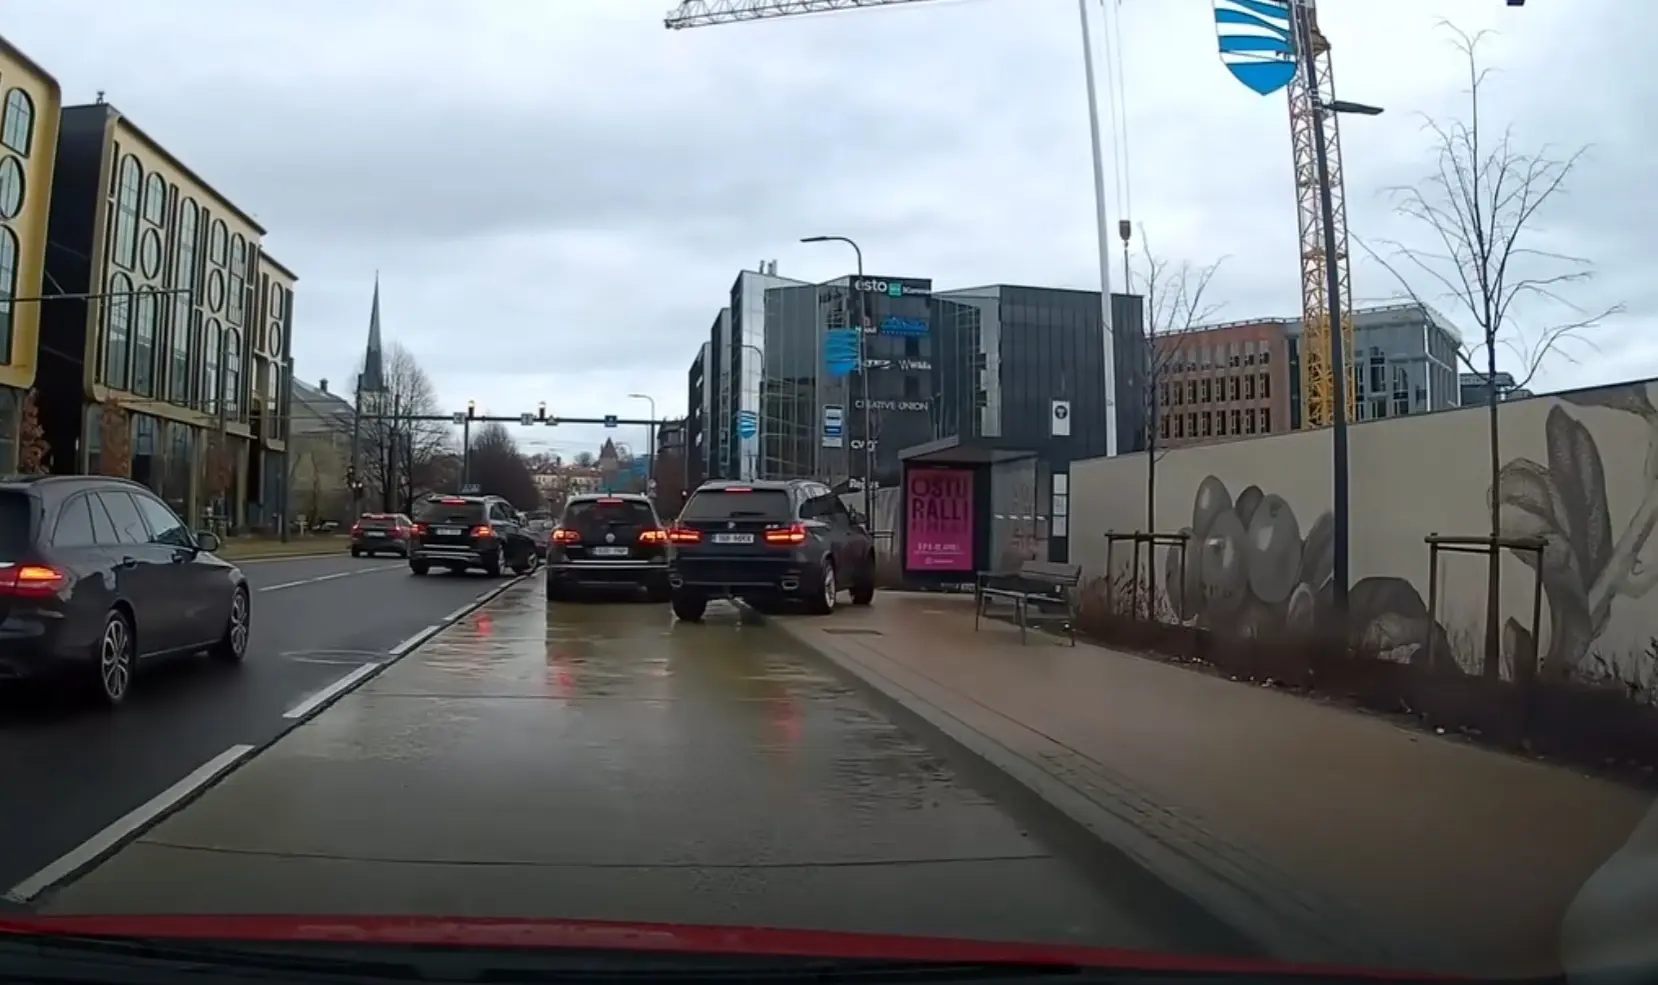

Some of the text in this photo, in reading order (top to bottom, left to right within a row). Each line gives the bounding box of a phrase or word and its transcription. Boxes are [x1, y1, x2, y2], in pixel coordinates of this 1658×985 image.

[854, 279, 888, 293] esto
[898, 401, 929, 412] UNION
[911, 476, 968, 498] OSTU
[912, 497, 969, 521] RALLI
